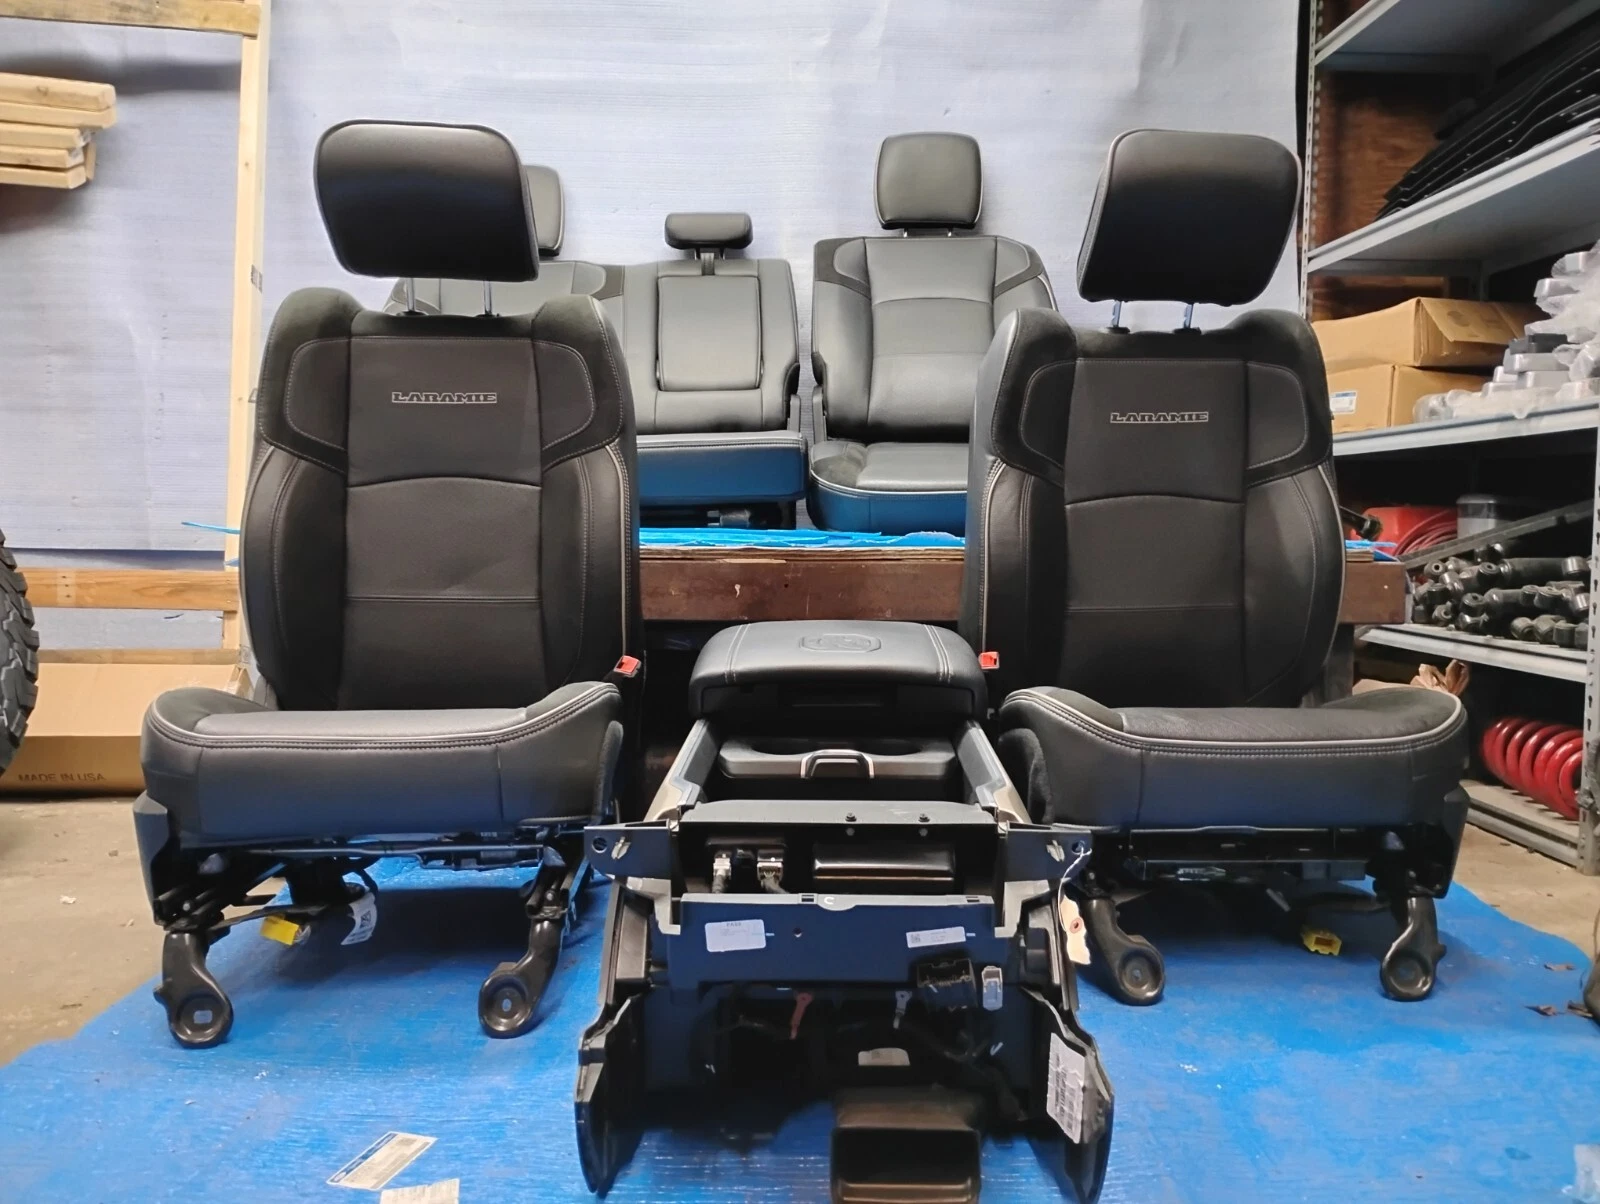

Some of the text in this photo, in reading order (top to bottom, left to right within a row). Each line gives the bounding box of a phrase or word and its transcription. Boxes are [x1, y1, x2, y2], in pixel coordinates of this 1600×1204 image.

[392, 391, 497, 404] LARAMIE
[1110, 411, 1209, 423] LARAMIE
[18, 773, 107, 781] MADE IN USA
